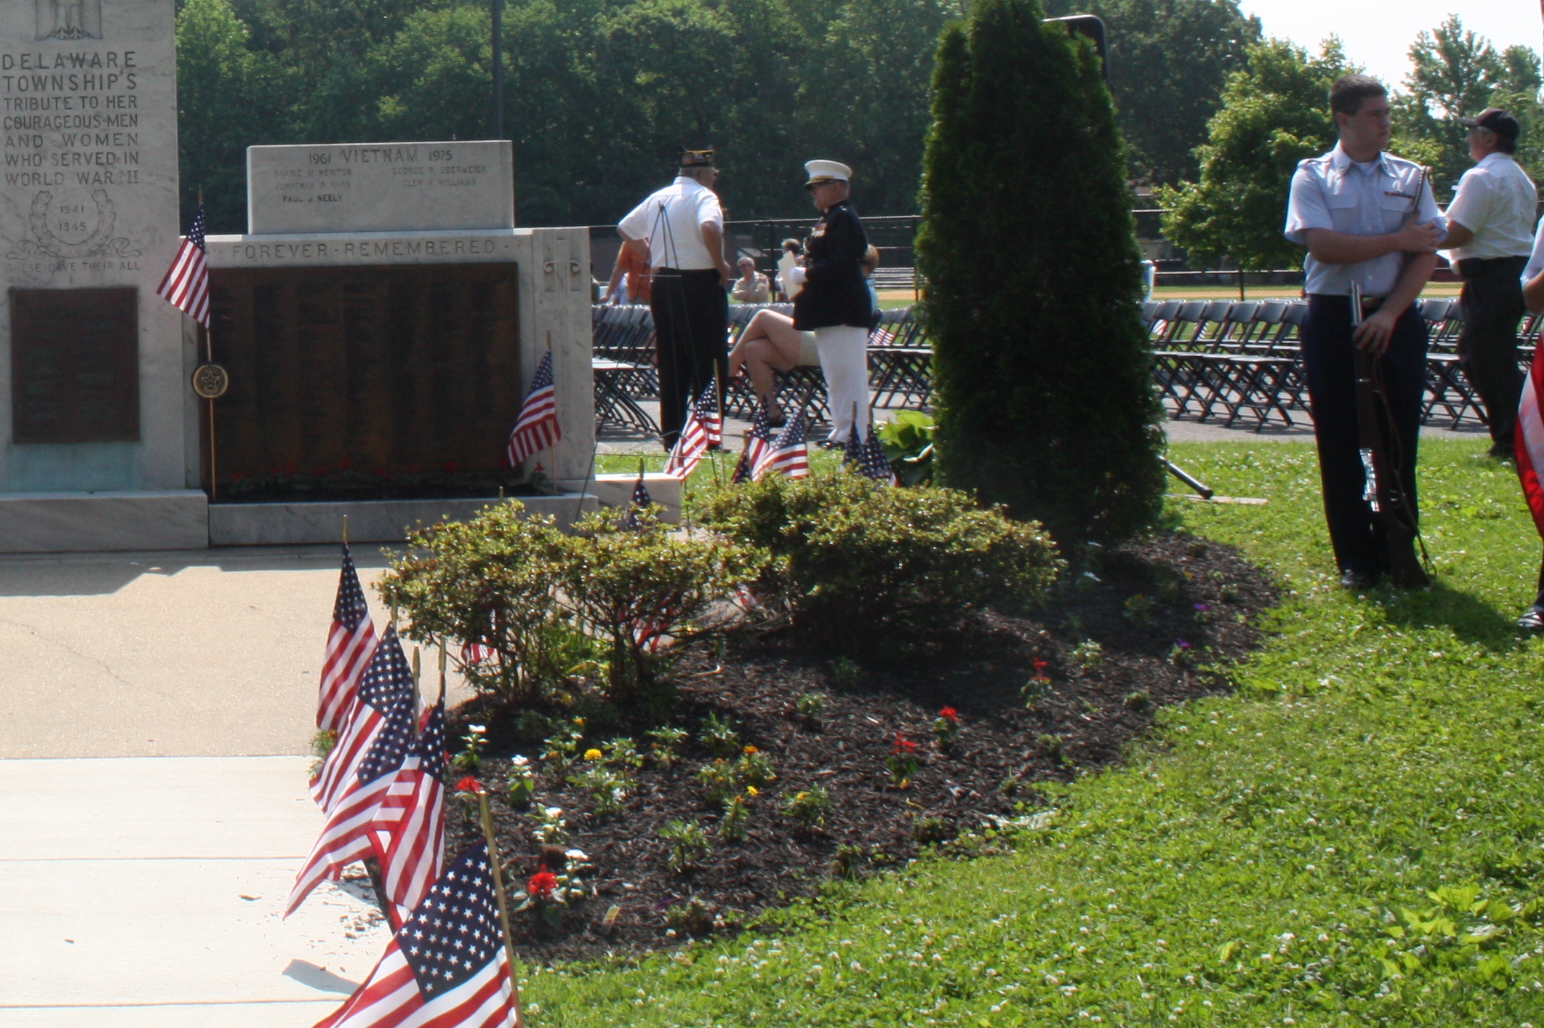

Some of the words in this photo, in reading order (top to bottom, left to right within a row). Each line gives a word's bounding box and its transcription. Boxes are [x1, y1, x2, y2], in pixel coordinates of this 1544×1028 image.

[2, 51, 136, 70] DELAWARE
[2, 70, 137, 92] TOWNSHIP'S
[3, 96, 73, 111] TRIBUTE
[78, 95, 99, 109] TO
[106, 95, 137, 109] HER
[3, 114, 101, 130] COURAGEOUS
[106, 113, 138, 128] MEN
[5, 134, 44, 148] AND
[61, 133, 138, 147] WOMEN
[4, 153, 42, 167] WHO
[51, 152, 116, 167] SERVED
[124, 151, 139, 165] IN
[309, 153, 331, 164] 1961
[341, 148, 418, 163] VIETNAM
[429, 150, 452, 161] 1975
[4, 172, 65, 187] WORLD
[76, 171, 114, 185] WAR
[126, 170, 139, 184] II
[282, 195, 303, 203] PAUL
[317, 194, 342, 202] NEELY
[60, 205, 84, 214] 1941
[59, 222, 86, 232] 1945
[232, 242, 328, 259] FOREVER
[345, 239, 495, 257] REMEMBERED
[82, 261, 113, 271] THEIR
[119, 261, 140, 271] ALL
